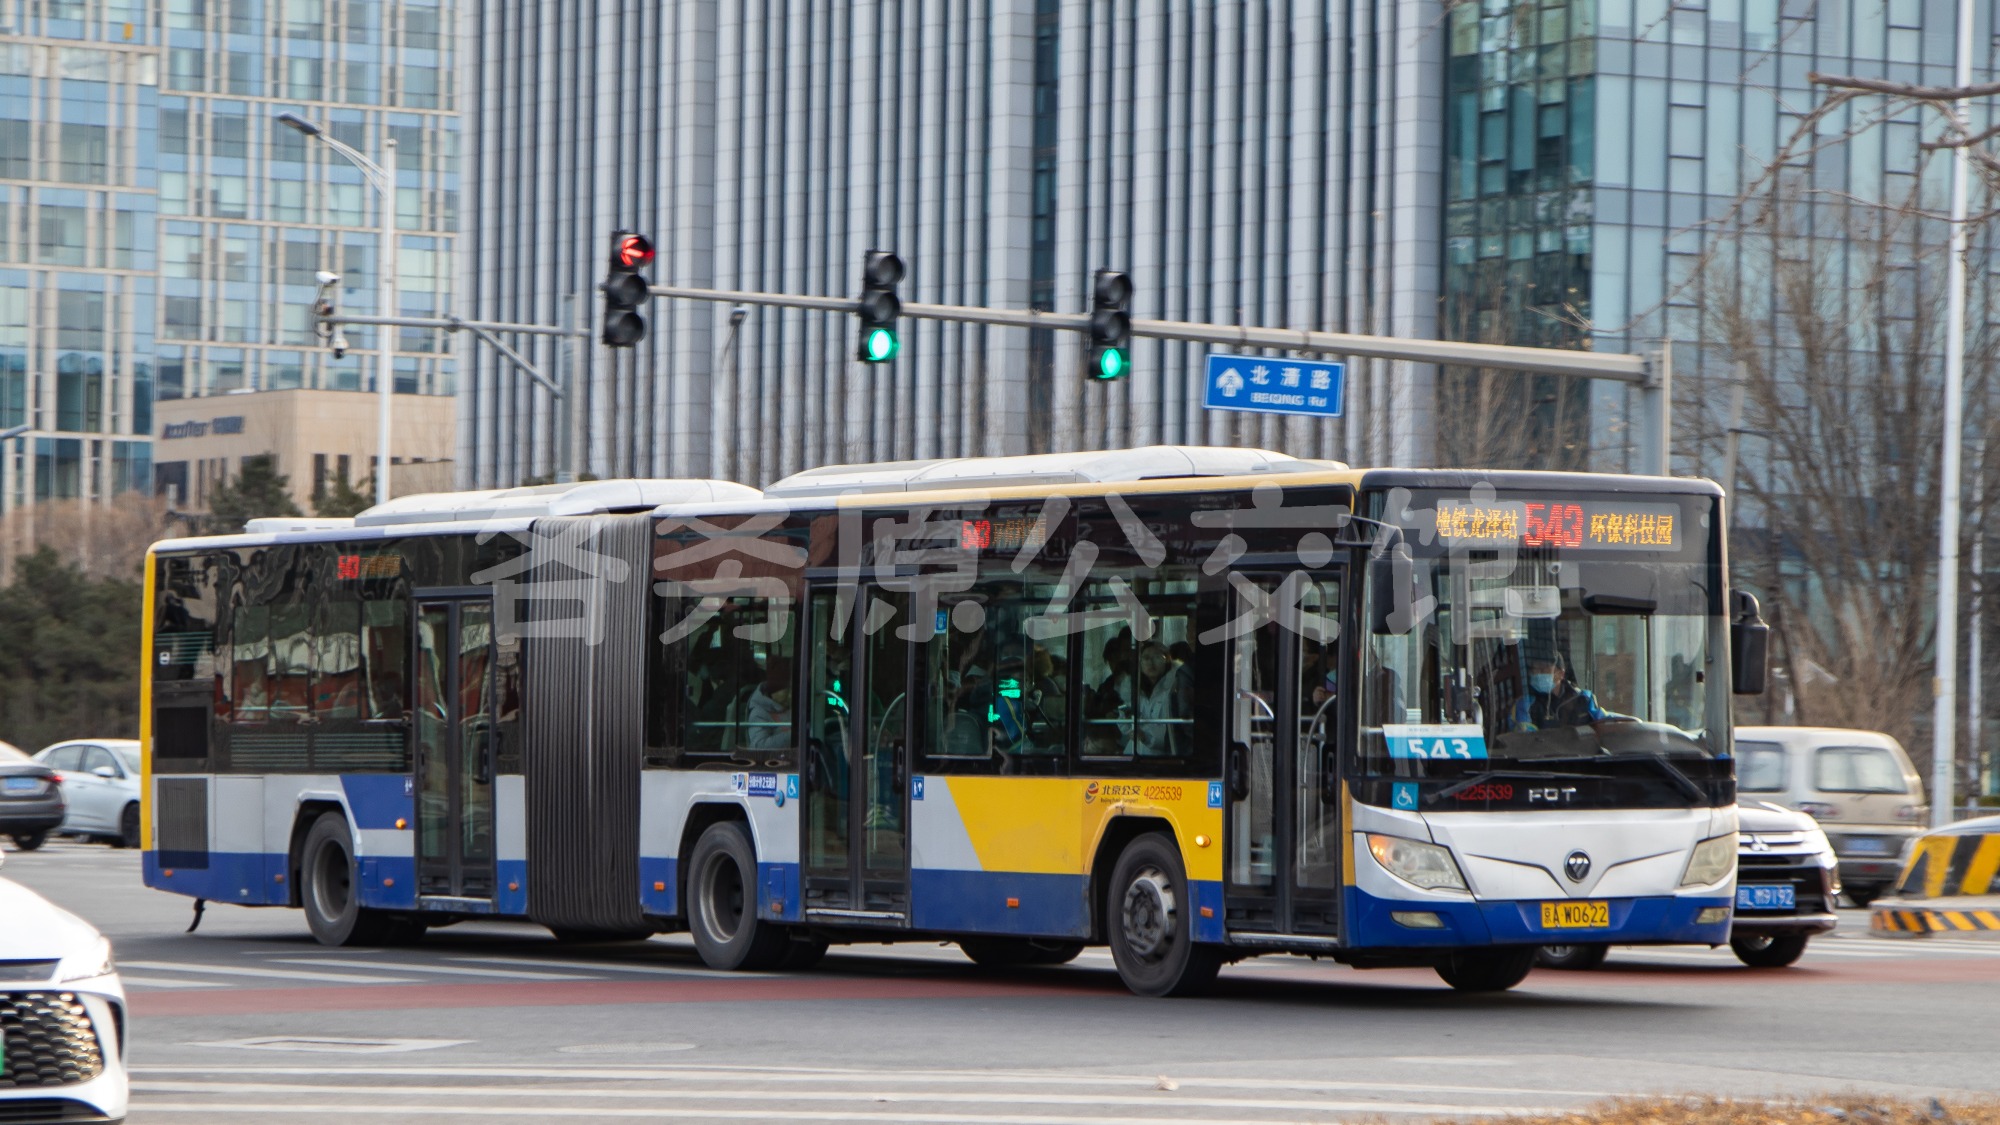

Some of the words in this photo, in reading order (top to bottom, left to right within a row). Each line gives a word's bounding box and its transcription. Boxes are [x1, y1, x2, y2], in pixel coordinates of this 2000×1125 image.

[1250, 365, 1331, 390] 北清路
[962, 519, 991, 550] 543
[1525, 503, 1584, 548] 543
[1590, 513, 1674, 545] 环保科技园
[1407, 738, 1471, 759] 543
[1102, 785, 1141, 796] 北京公交
[1143, 785, 1183, 801] 4225539
